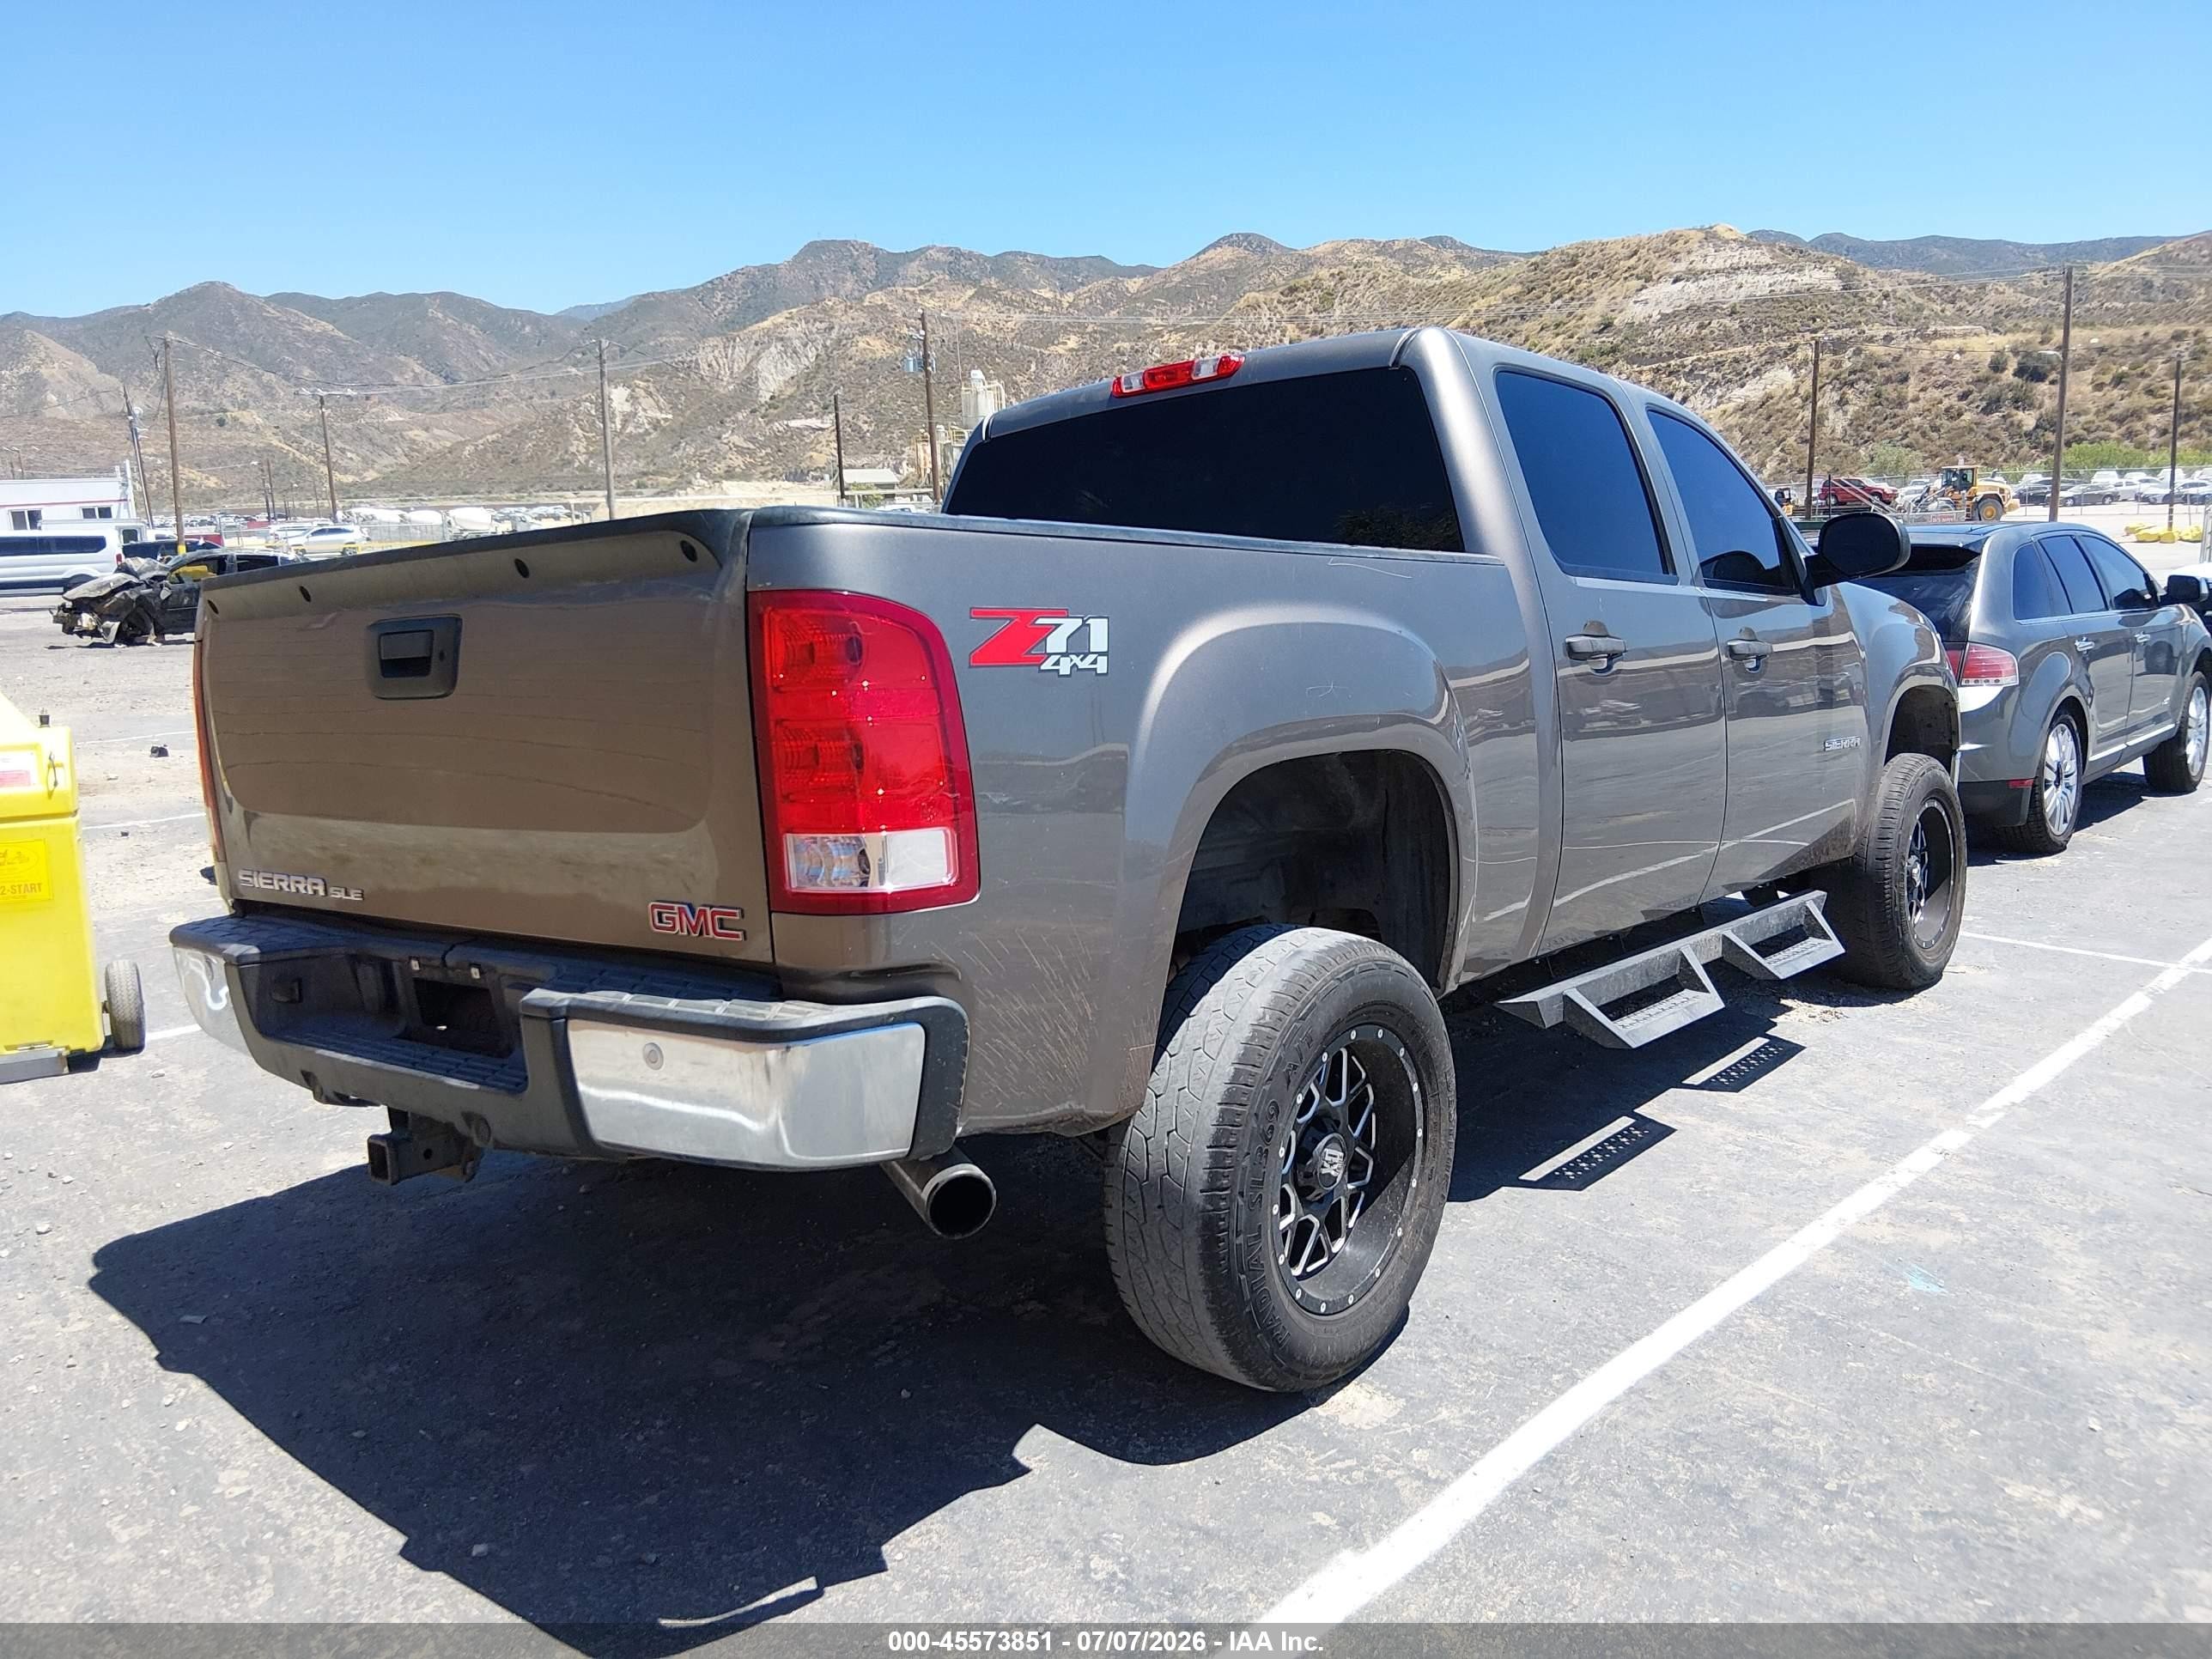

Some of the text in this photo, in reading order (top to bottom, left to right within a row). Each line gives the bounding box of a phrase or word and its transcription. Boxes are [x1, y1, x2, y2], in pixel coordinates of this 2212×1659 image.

[969, 607, 1109, 667] Z71
[1824, 736, 1861, 751] SIERRA
[238, 869, 364, 901] SIERRA SLE
[648, 902, 744, 941] GMC
[1249, 1100, 1279, 1211] SL369
[1246, 1223, 1291, 1351] RADIAL
